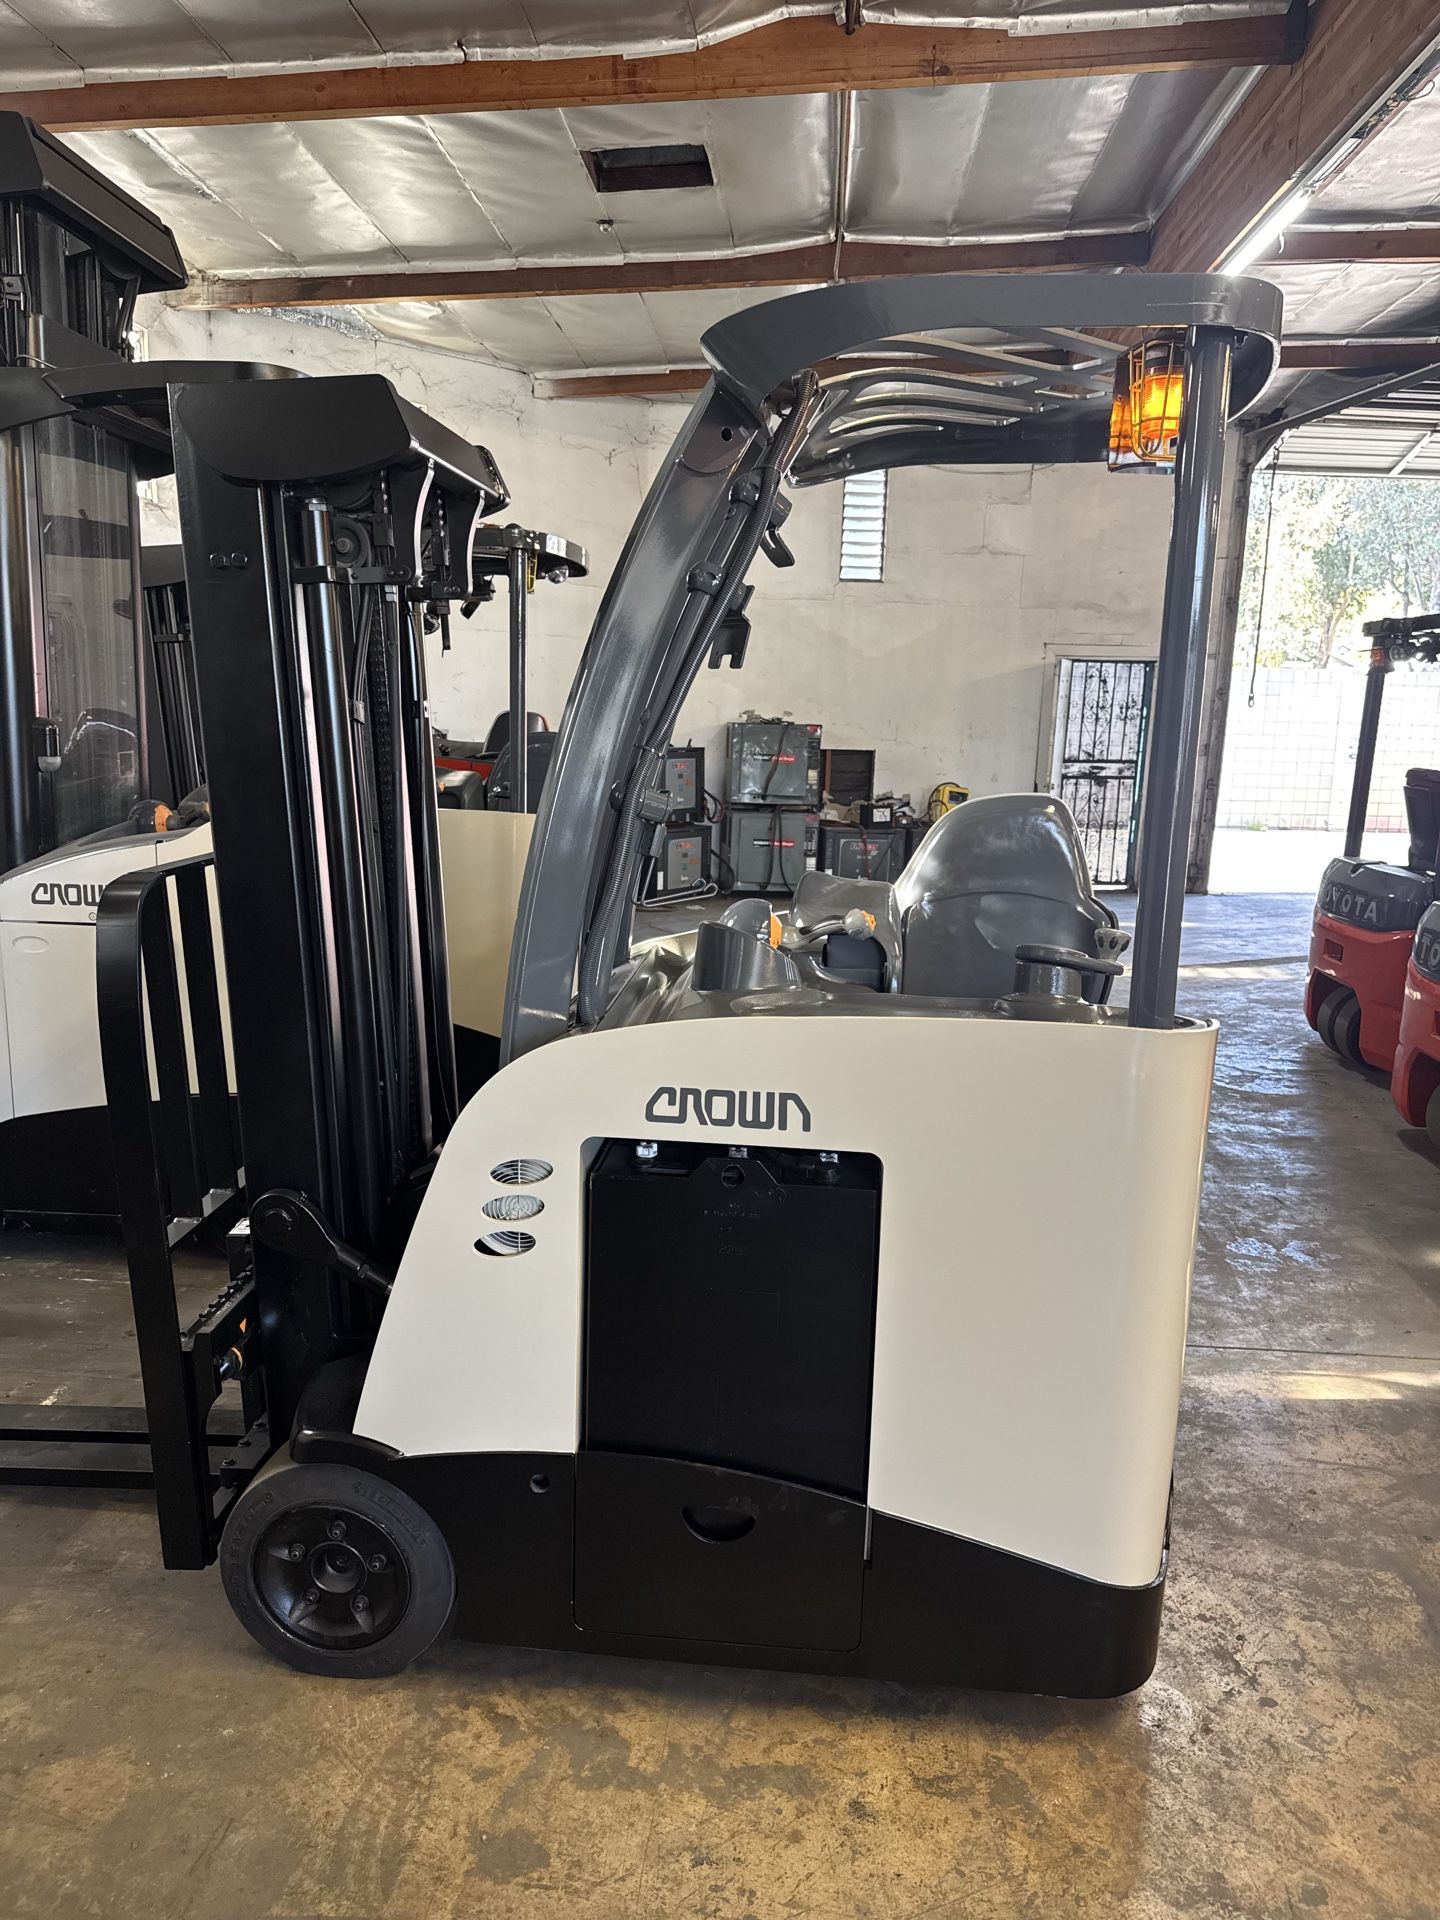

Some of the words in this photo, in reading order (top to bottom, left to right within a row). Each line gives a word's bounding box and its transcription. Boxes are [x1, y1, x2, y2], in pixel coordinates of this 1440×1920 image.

[31, 883, 108, 907] CROW
[1324, 883, 1377, 922] OYOTA
[645, 1086, 811, 1132] CROWN
